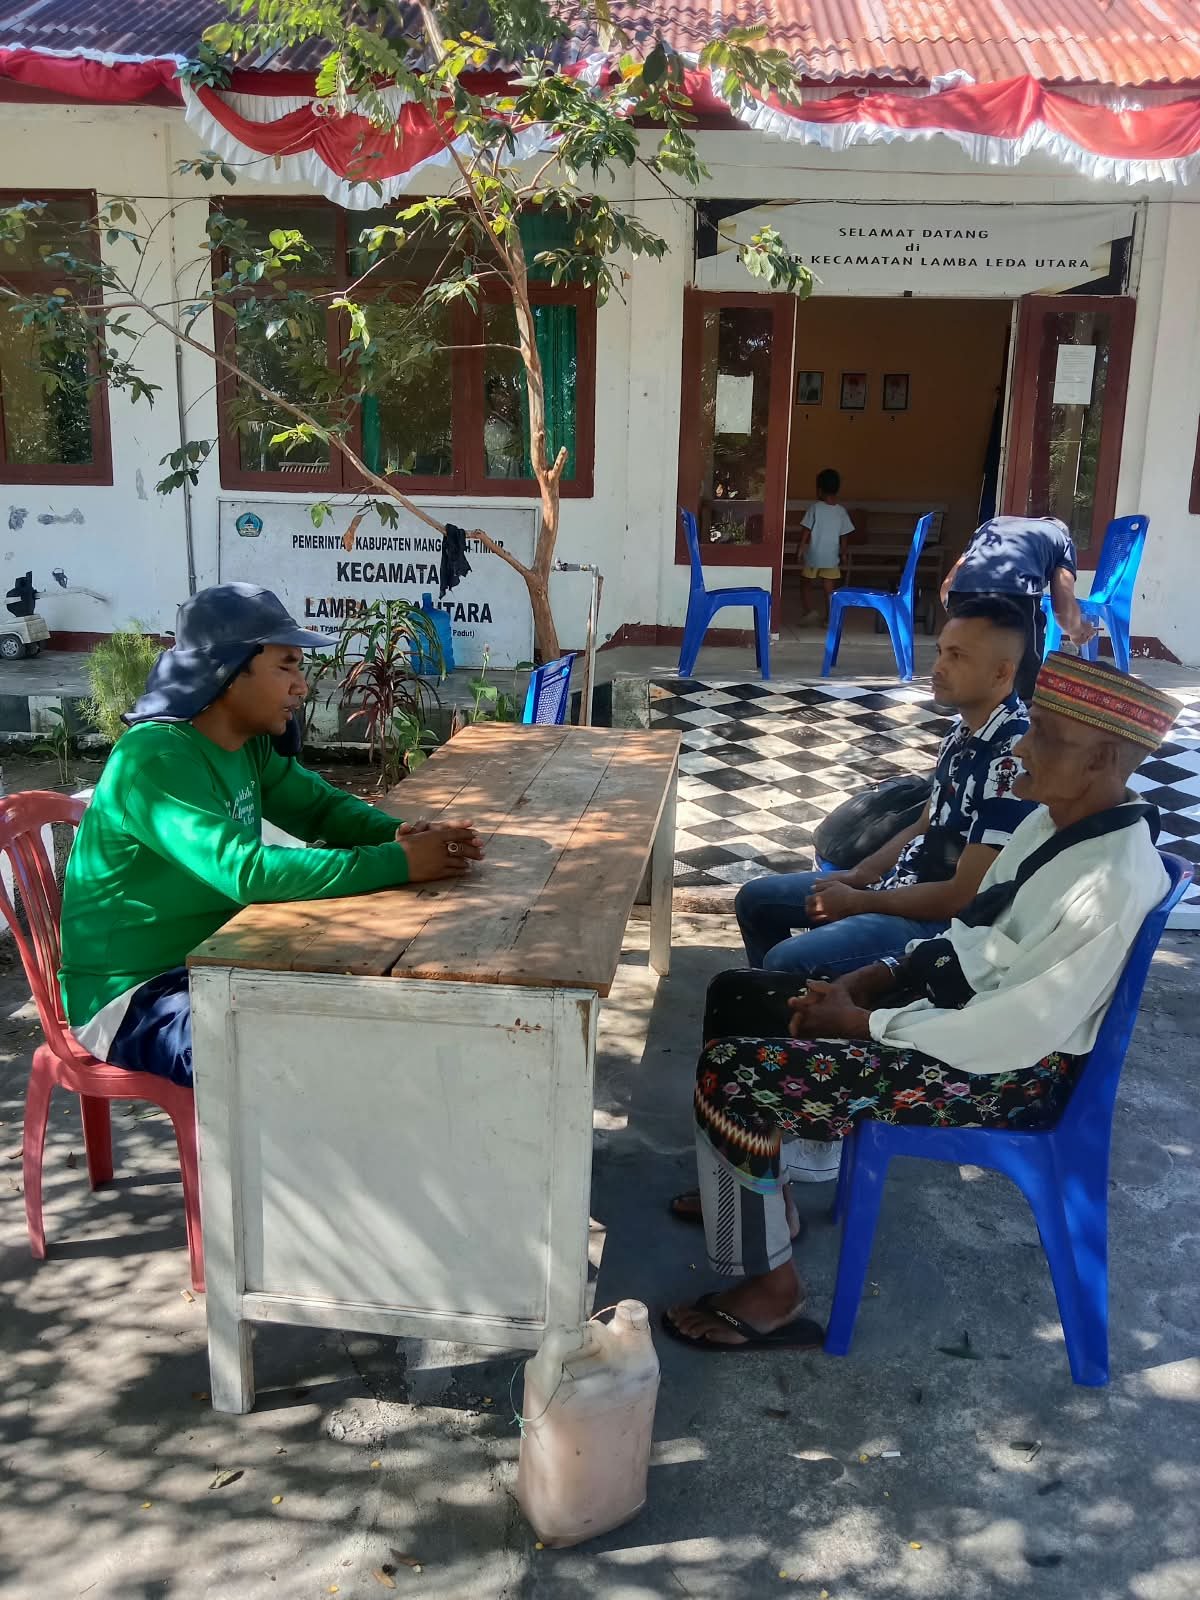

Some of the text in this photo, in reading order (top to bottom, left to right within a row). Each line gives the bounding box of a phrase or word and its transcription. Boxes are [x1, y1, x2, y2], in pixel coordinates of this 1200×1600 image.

[838, 227, 989, 239] SELAMAT DATANG
[905, 242, 920, 252] di
[810, 255, 914, 266] KECAMATAN
[920, 257, 978, 267] LAMBA
[986, 258, 1027, 268] LEDA
[1035, 258, 1090, 269] UTARA
[292, 534, 353, 550] PEMERINTA
[355, 536, 412, 552] KABUPATEN
[336, 561, 441, 585] KECAMATA
